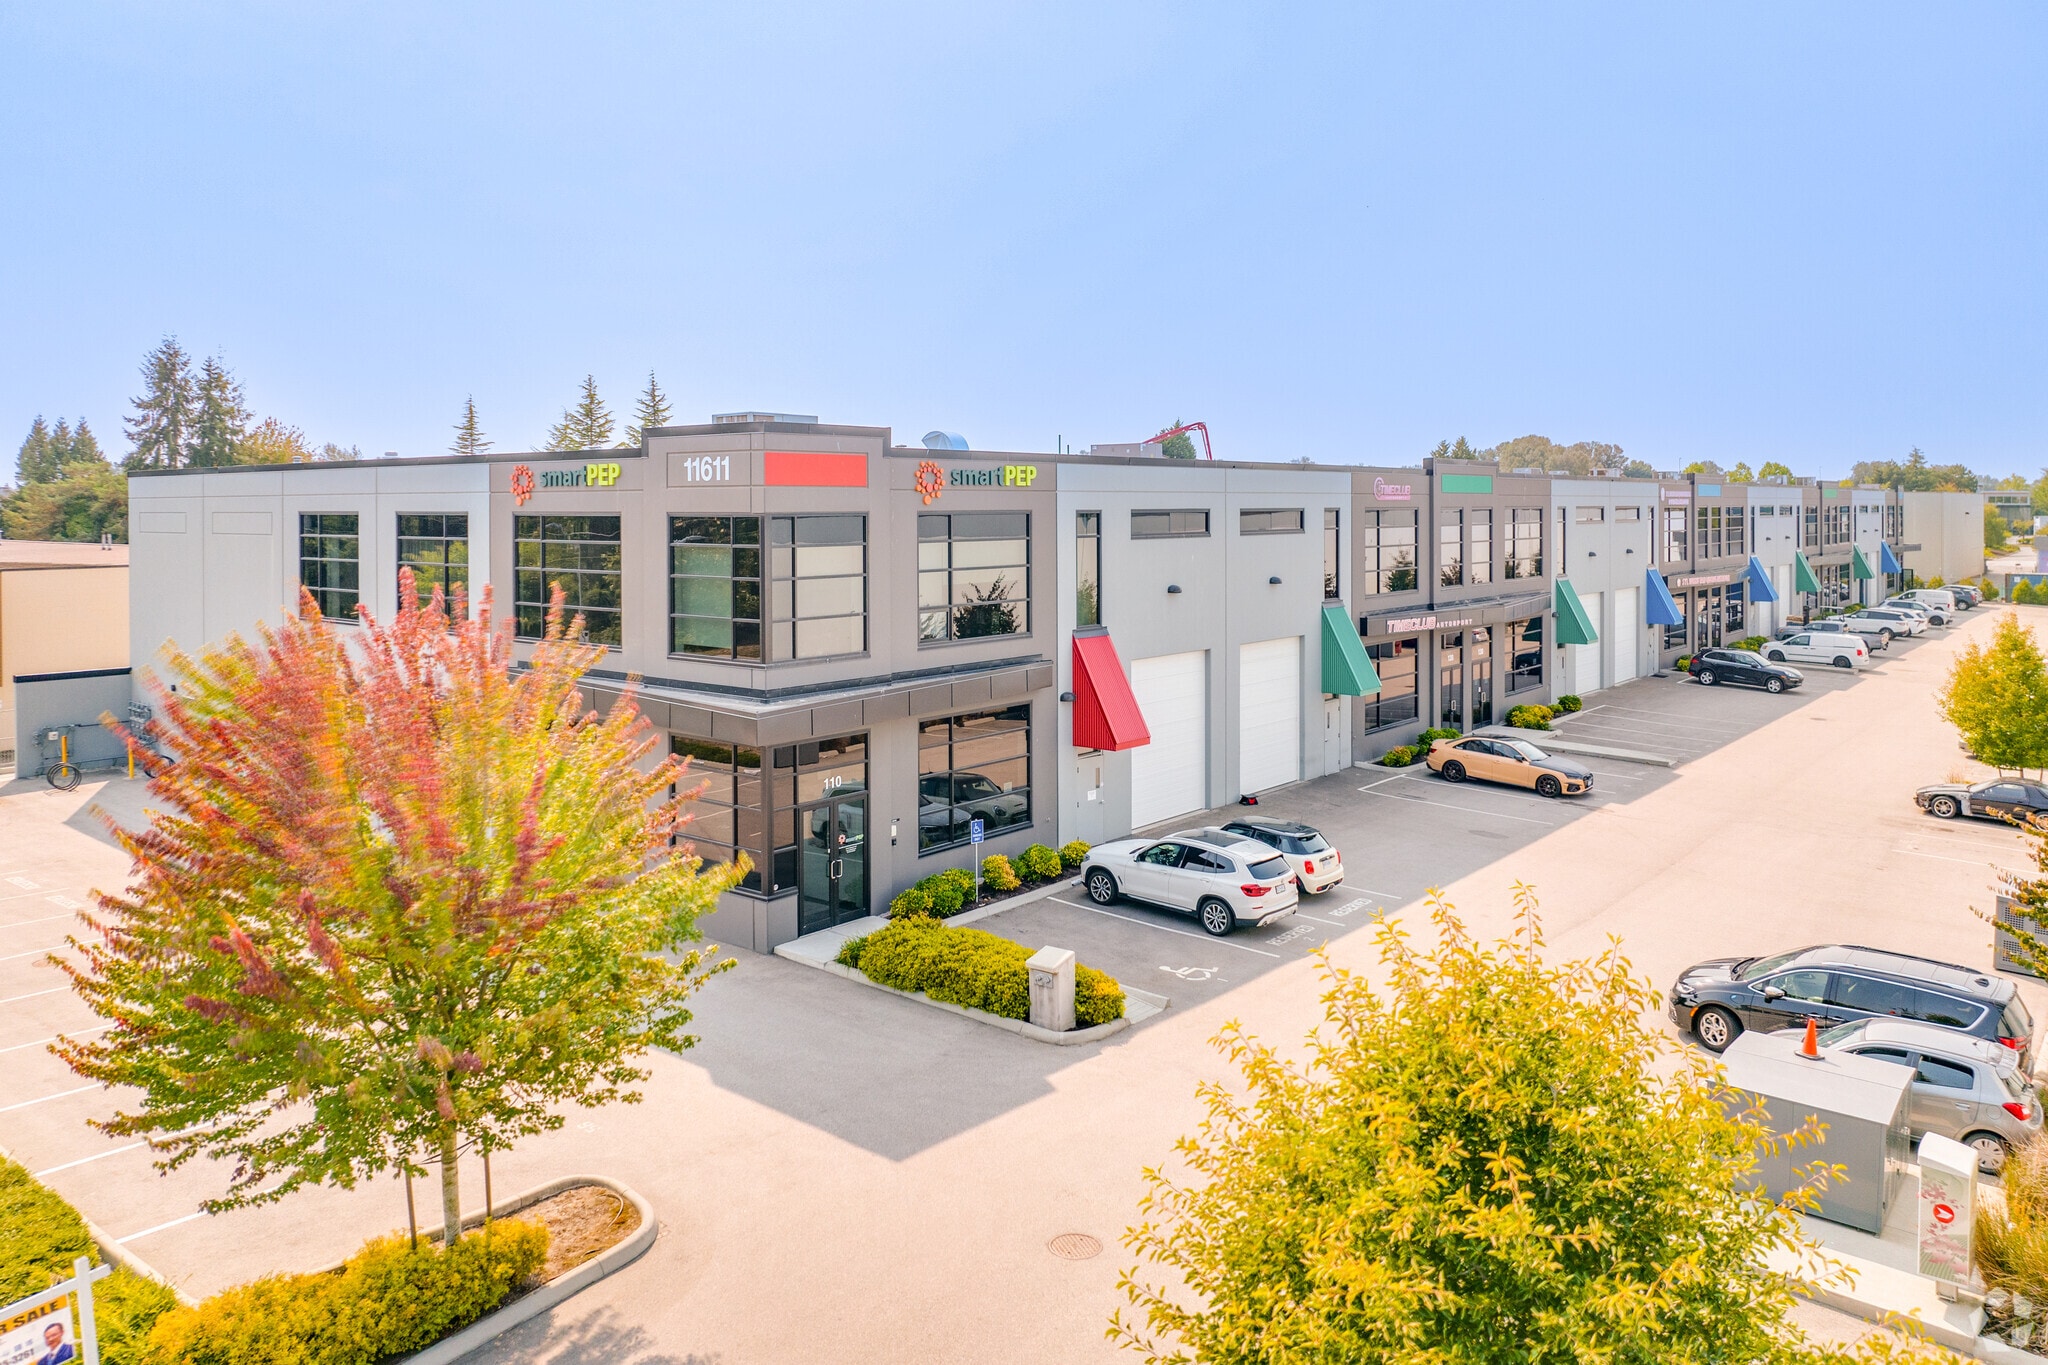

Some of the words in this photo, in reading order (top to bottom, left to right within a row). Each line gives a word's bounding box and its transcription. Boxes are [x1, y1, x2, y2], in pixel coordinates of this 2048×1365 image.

[540, 463, 621, 487] smartPEP
[683, 456, 730, 482] 11611
[950, 465, 1037, 486] smartPEP
[1387, 616, 1437, 633] TIMECLUB
[824, 775, 842, 790] 110
[1328, 898, 1372, 916] RESERVED
[1265, 925, 1315, 946] RESERVED
[13, 1300, 58, 1327] SALE
